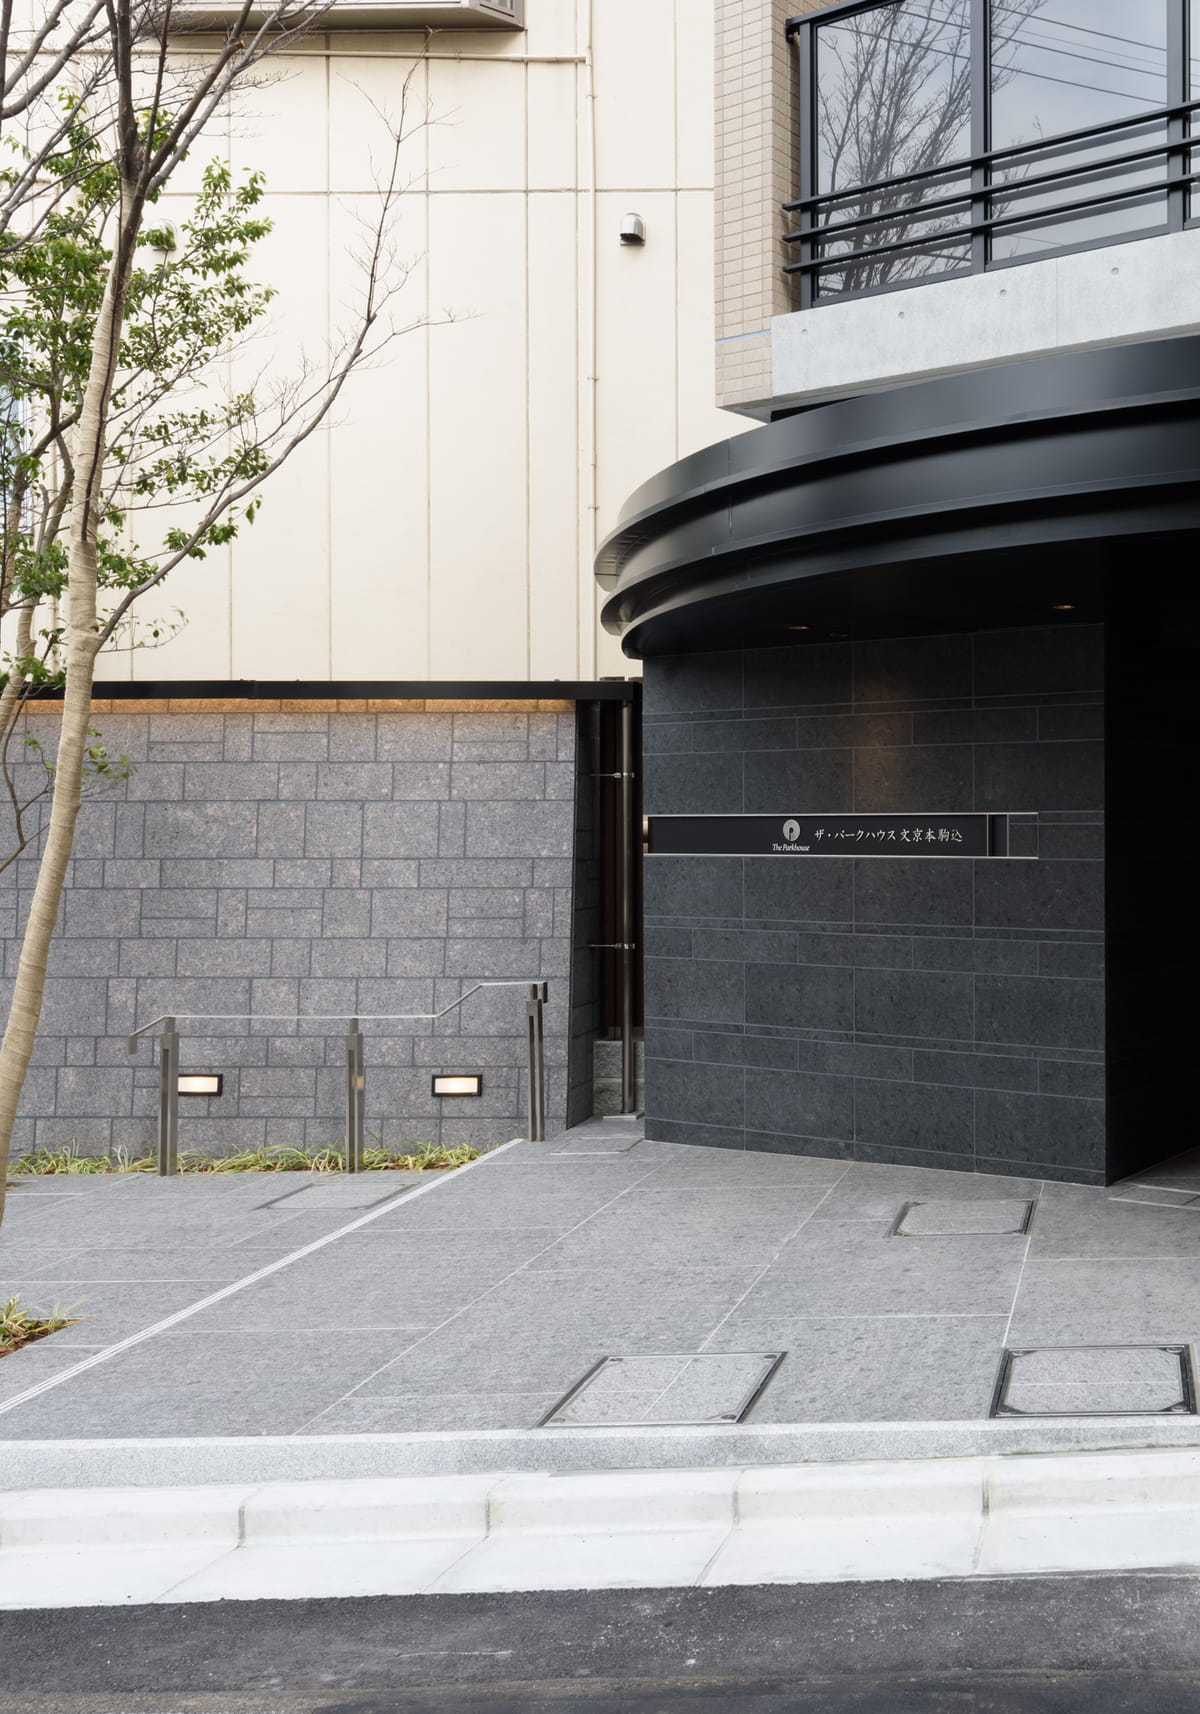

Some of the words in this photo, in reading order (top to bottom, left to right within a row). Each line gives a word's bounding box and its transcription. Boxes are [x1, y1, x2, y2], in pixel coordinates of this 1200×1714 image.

[814, 828, 896, 842] ザ・パークハウス
[900, 828, 963, 842] 文京本駒込
[772, 843, 782, 851] The
[782, 843, 810, 852] Parkhouse
